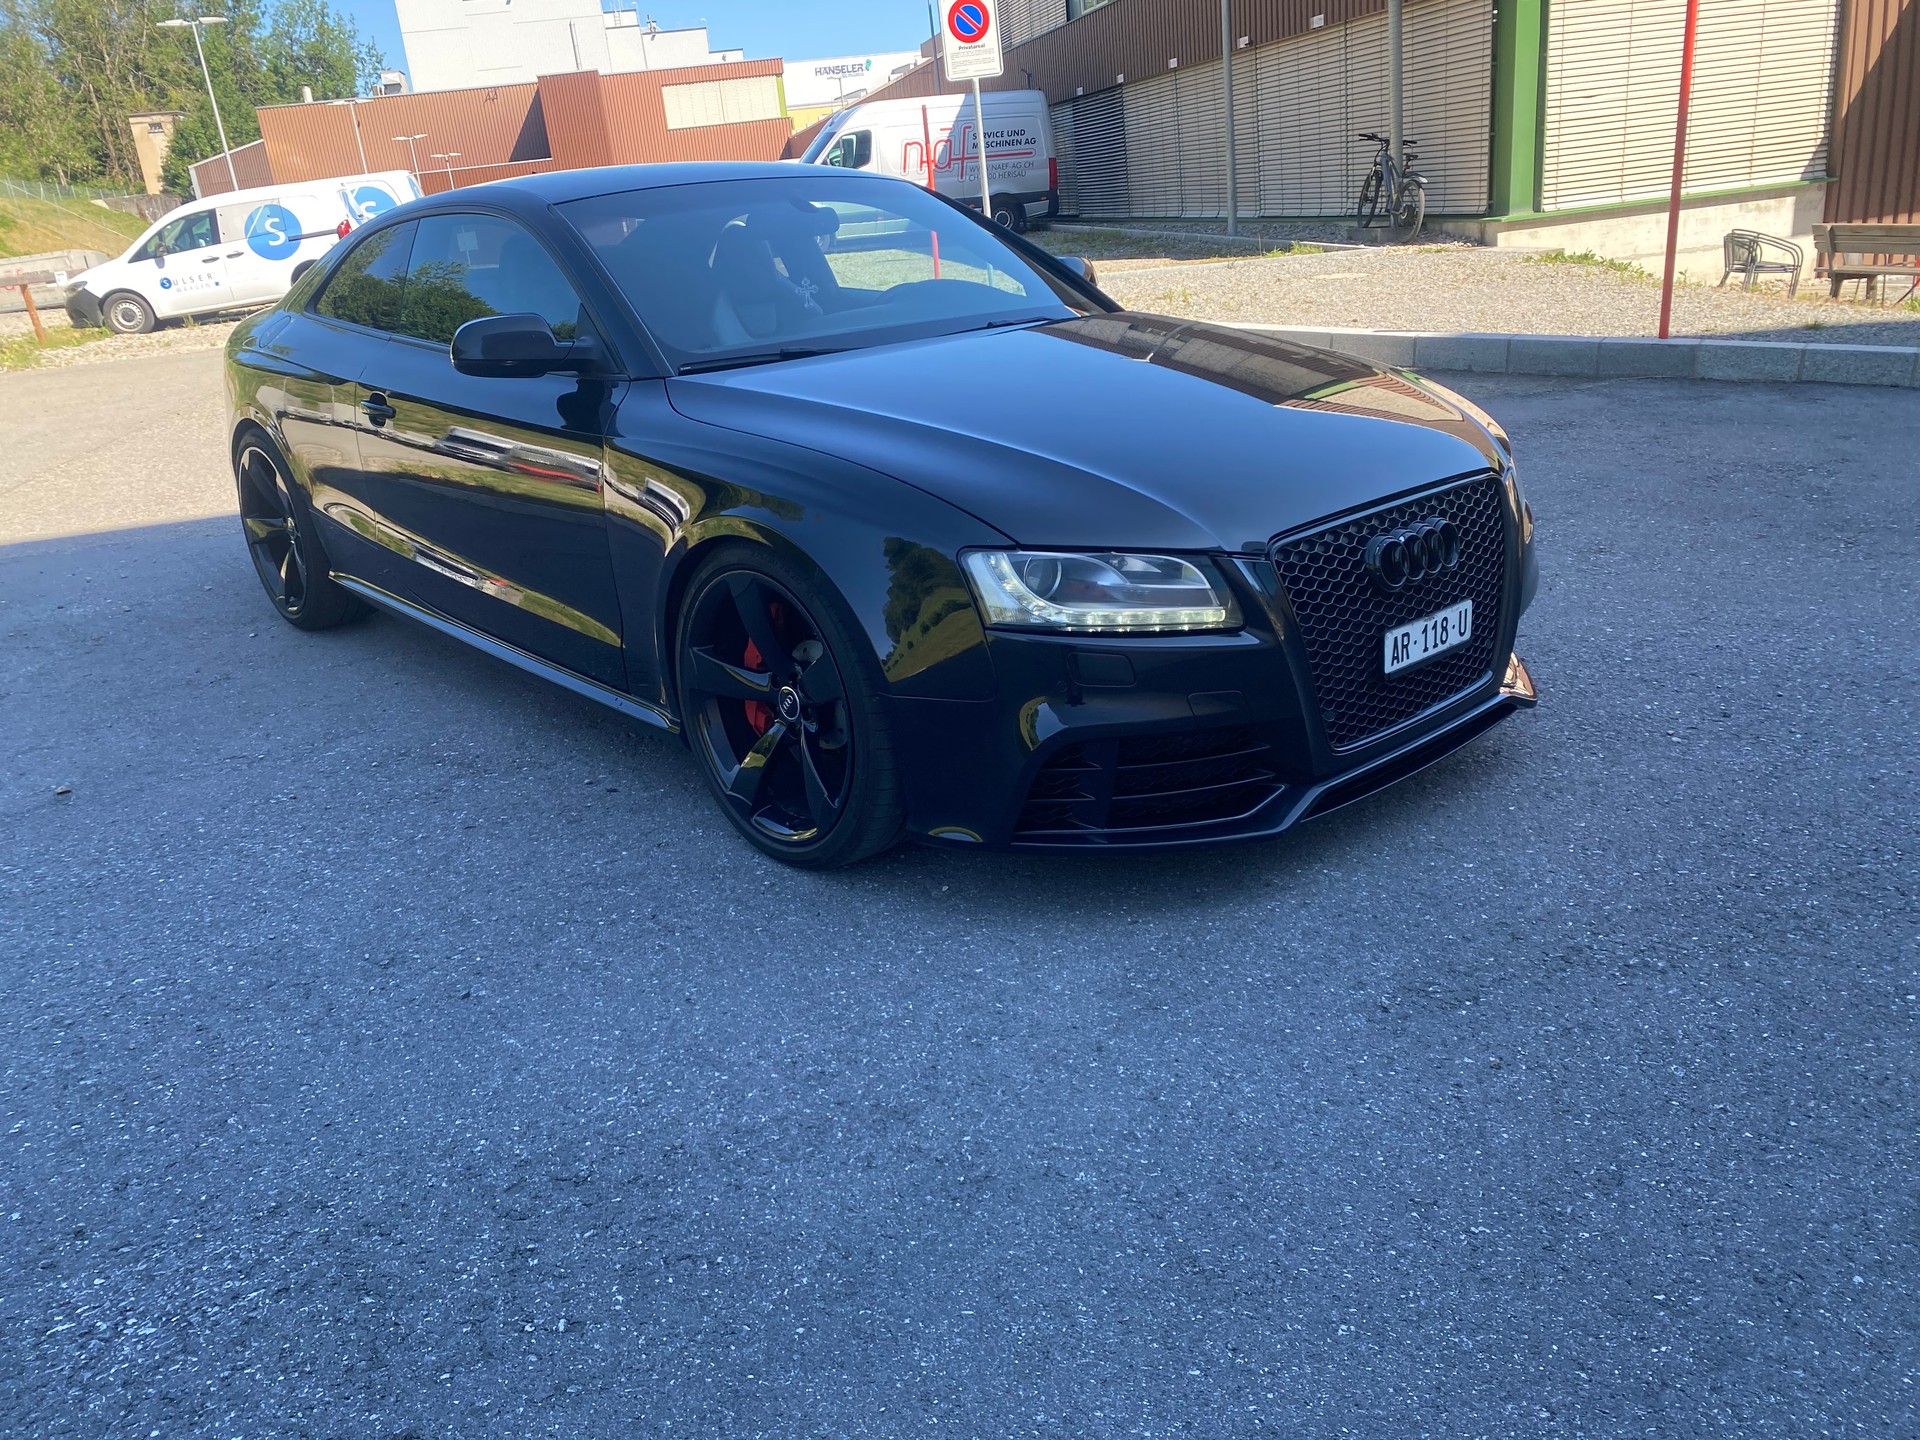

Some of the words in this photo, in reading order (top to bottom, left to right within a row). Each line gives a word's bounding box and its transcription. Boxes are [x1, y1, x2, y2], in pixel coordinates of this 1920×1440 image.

[972, 130, 1005, 140] SRVICE
[1006, 129, 1026, 137] UND
[972, 139, 1023, 149] MSCHINEN
[1024, 137, 1037, 146] AG
[998, 170, 1027, 179] HERISAU
